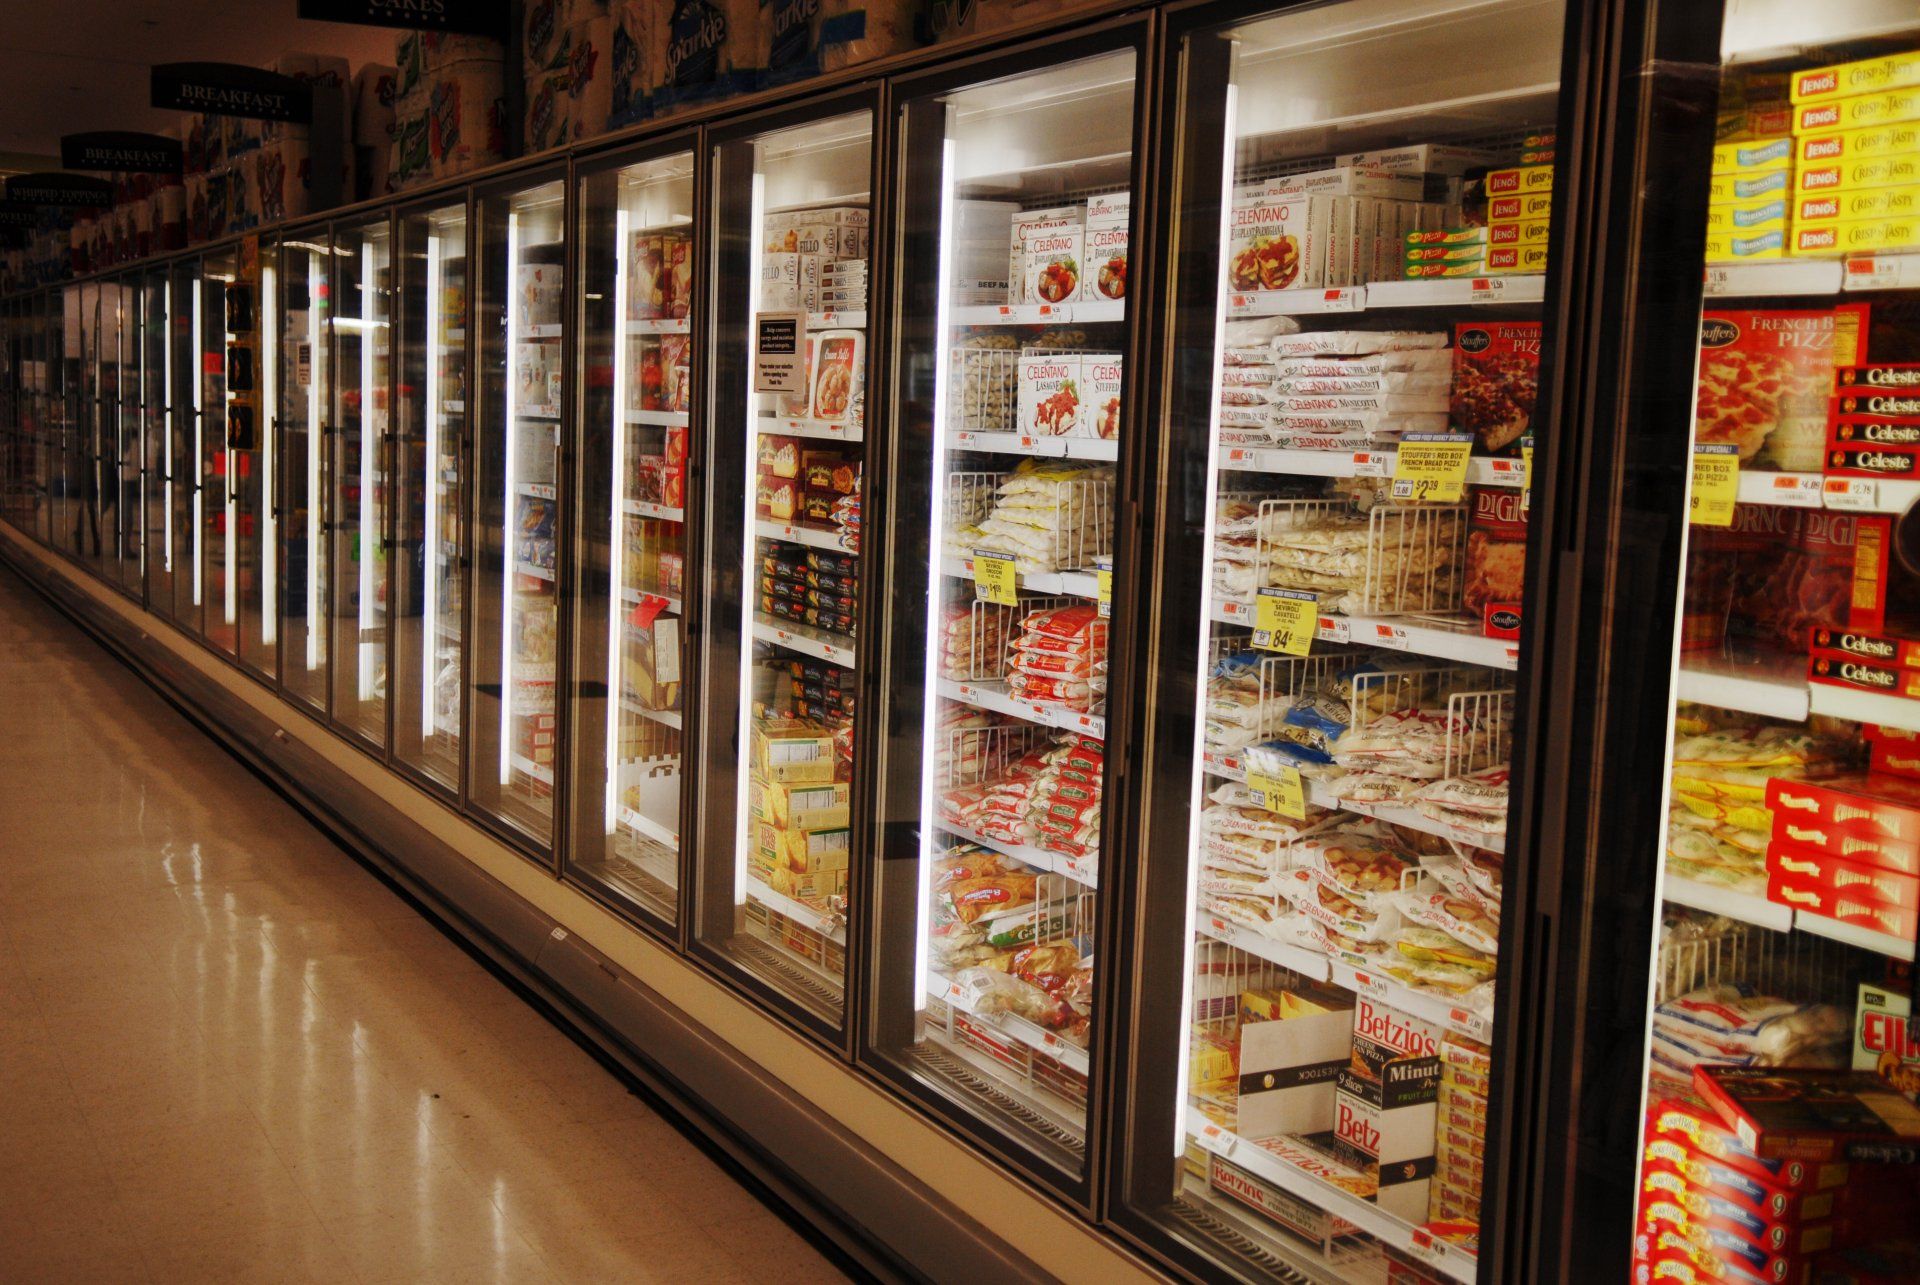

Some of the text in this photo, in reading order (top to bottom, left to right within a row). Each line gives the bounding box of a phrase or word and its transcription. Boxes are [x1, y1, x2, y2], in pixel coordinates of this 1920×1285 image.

[1850, 68, 1878, 86] CRISP
[181, 83, 286, 110] BREAKFAST
[1852, 102, 1878, 120] CRISP
[1854, 135, 1881, 152] CRISP
[85, 147, 168, 164] BREAKFAST
[1527, 171, 1547, 186] CRISP
[1852, 165, 1878, 183] CRISP
[11, 187, 58, 200] WHIPPED
[1528, 198, 1547, 213] CRISP
[1851, 195, 1878, 212] CRISP
[1230, 206, 1289, 227] CELENTANO
[1525, 223, 1545, 239] CRISP
[1848, 226, 1876, 244] CRISP
[800, 239, 819, 254] FILLO
[1033, 238, 1073, 253] CELENTANO
[1524, 249, 1544, 265] CRISP
[762, 266, 780, 281] FILLO
[978, 281, 997, 289] BEEF
[1751, 316, 1817, 331] FRENCH
[1027, 365, 1069, 381] CELENTANO
[1299, 365, 1346, 378] CELENTANO
[1294, 380, 1341, 392] CELENTANO
[1288, 399, 1338, 411] CELENTANO
[1284, 417, 1328, 430] CELENTANO
[1865, 424, 1919, 441] Celeste
[1292, 437, 1339, 449] CELENTANO
[1401, 451, 1437, 459] STOUFFER'S
[1424, 459, 1443, 467] BREAD
[1856, 451, 1911, 469] Celeste
[1694, 464, 1731, 473] RED BOX
[1273, 610, 1301, 619] CAVATELLI
[1275, 604, 1300, 612] SEVIROLI
[1841, 633, 1894, 657] Celeste
[1841, 662, 1894, 686] Celeste
[1300, 900, 1336, 925] CELENTANO
[1358, 1000, 1437, 1058] Betzio's
[1365, 1048, 1385, 1064] PIZZA
[1339, 1072, 1345, 1084] 9
[1389, 1062, 1440, 1083] Minut
[1398, 1090, 1420, 1102] FRUIT
[1338, 1103, 1381, 1153] Betz
